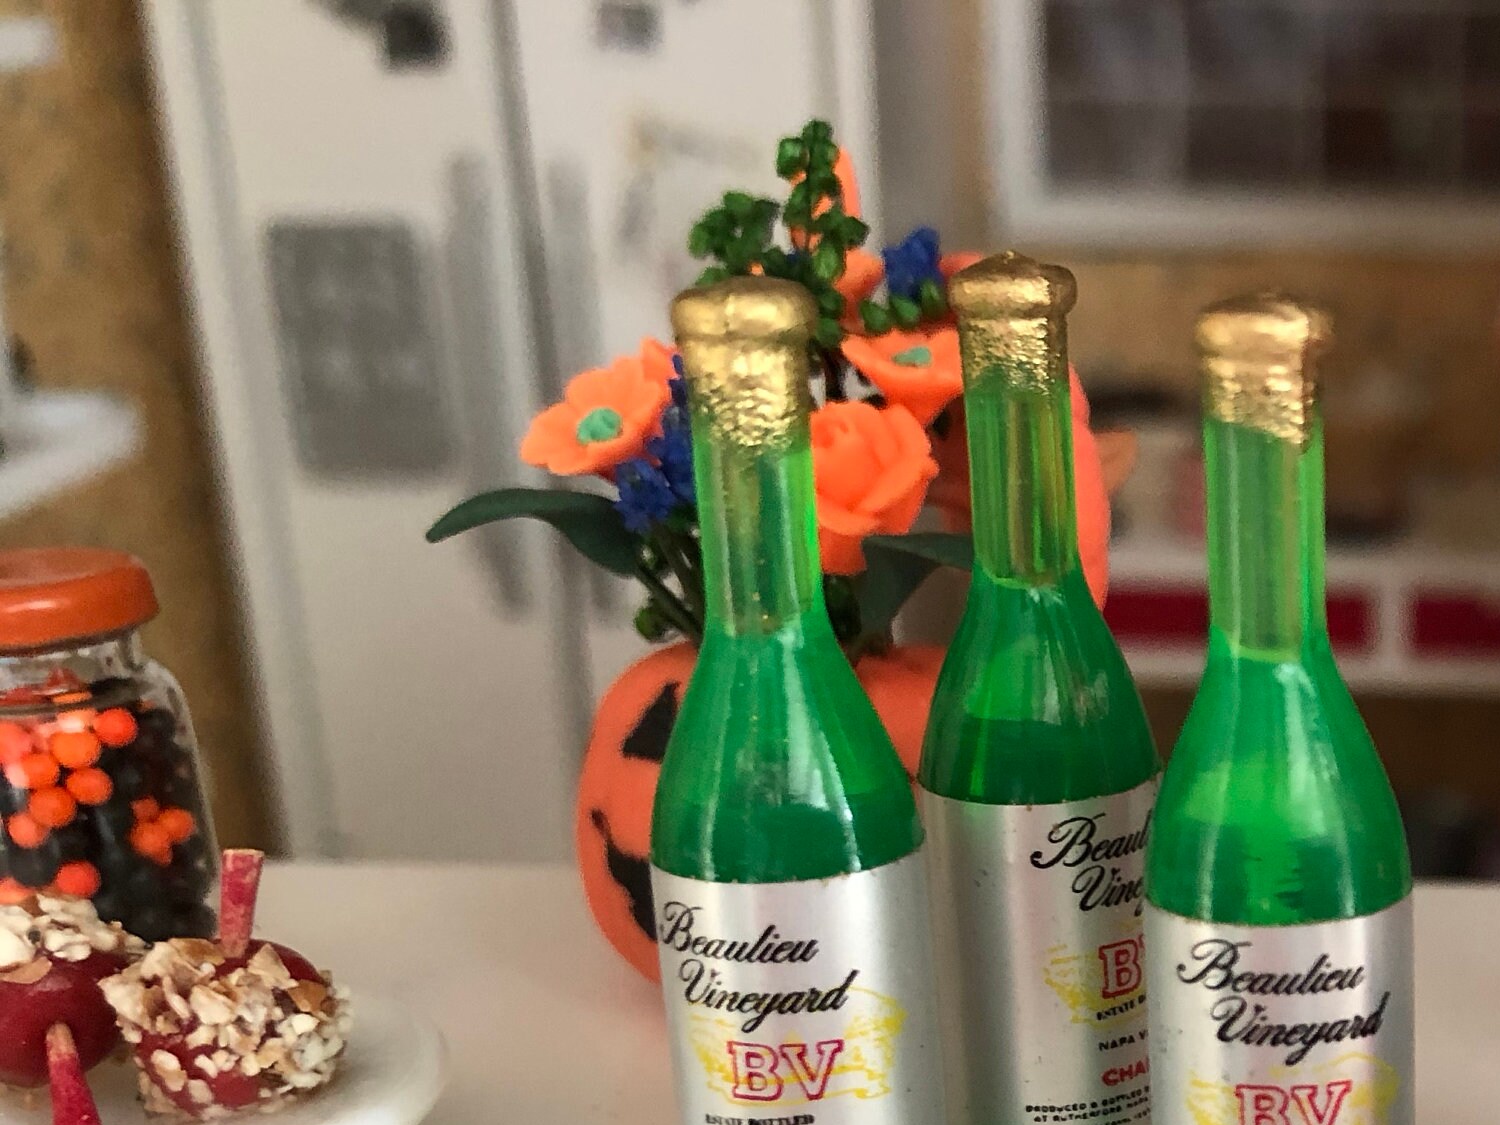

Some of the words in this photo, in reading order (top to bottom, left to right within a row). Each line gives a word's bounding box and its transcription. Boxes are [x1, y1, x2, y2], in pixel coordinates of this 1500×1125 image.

[660, 900, 819, 965] Beaulieu
[680, 958, 861, 1034] Vineyard
[1176, 938, 1366, 995] Beaulieu
[1209, 991, 1391, 1067] Vineyard
[727, 1038, 845, 1102] BV
[1102, 1057, 1149, 1087] CHA
